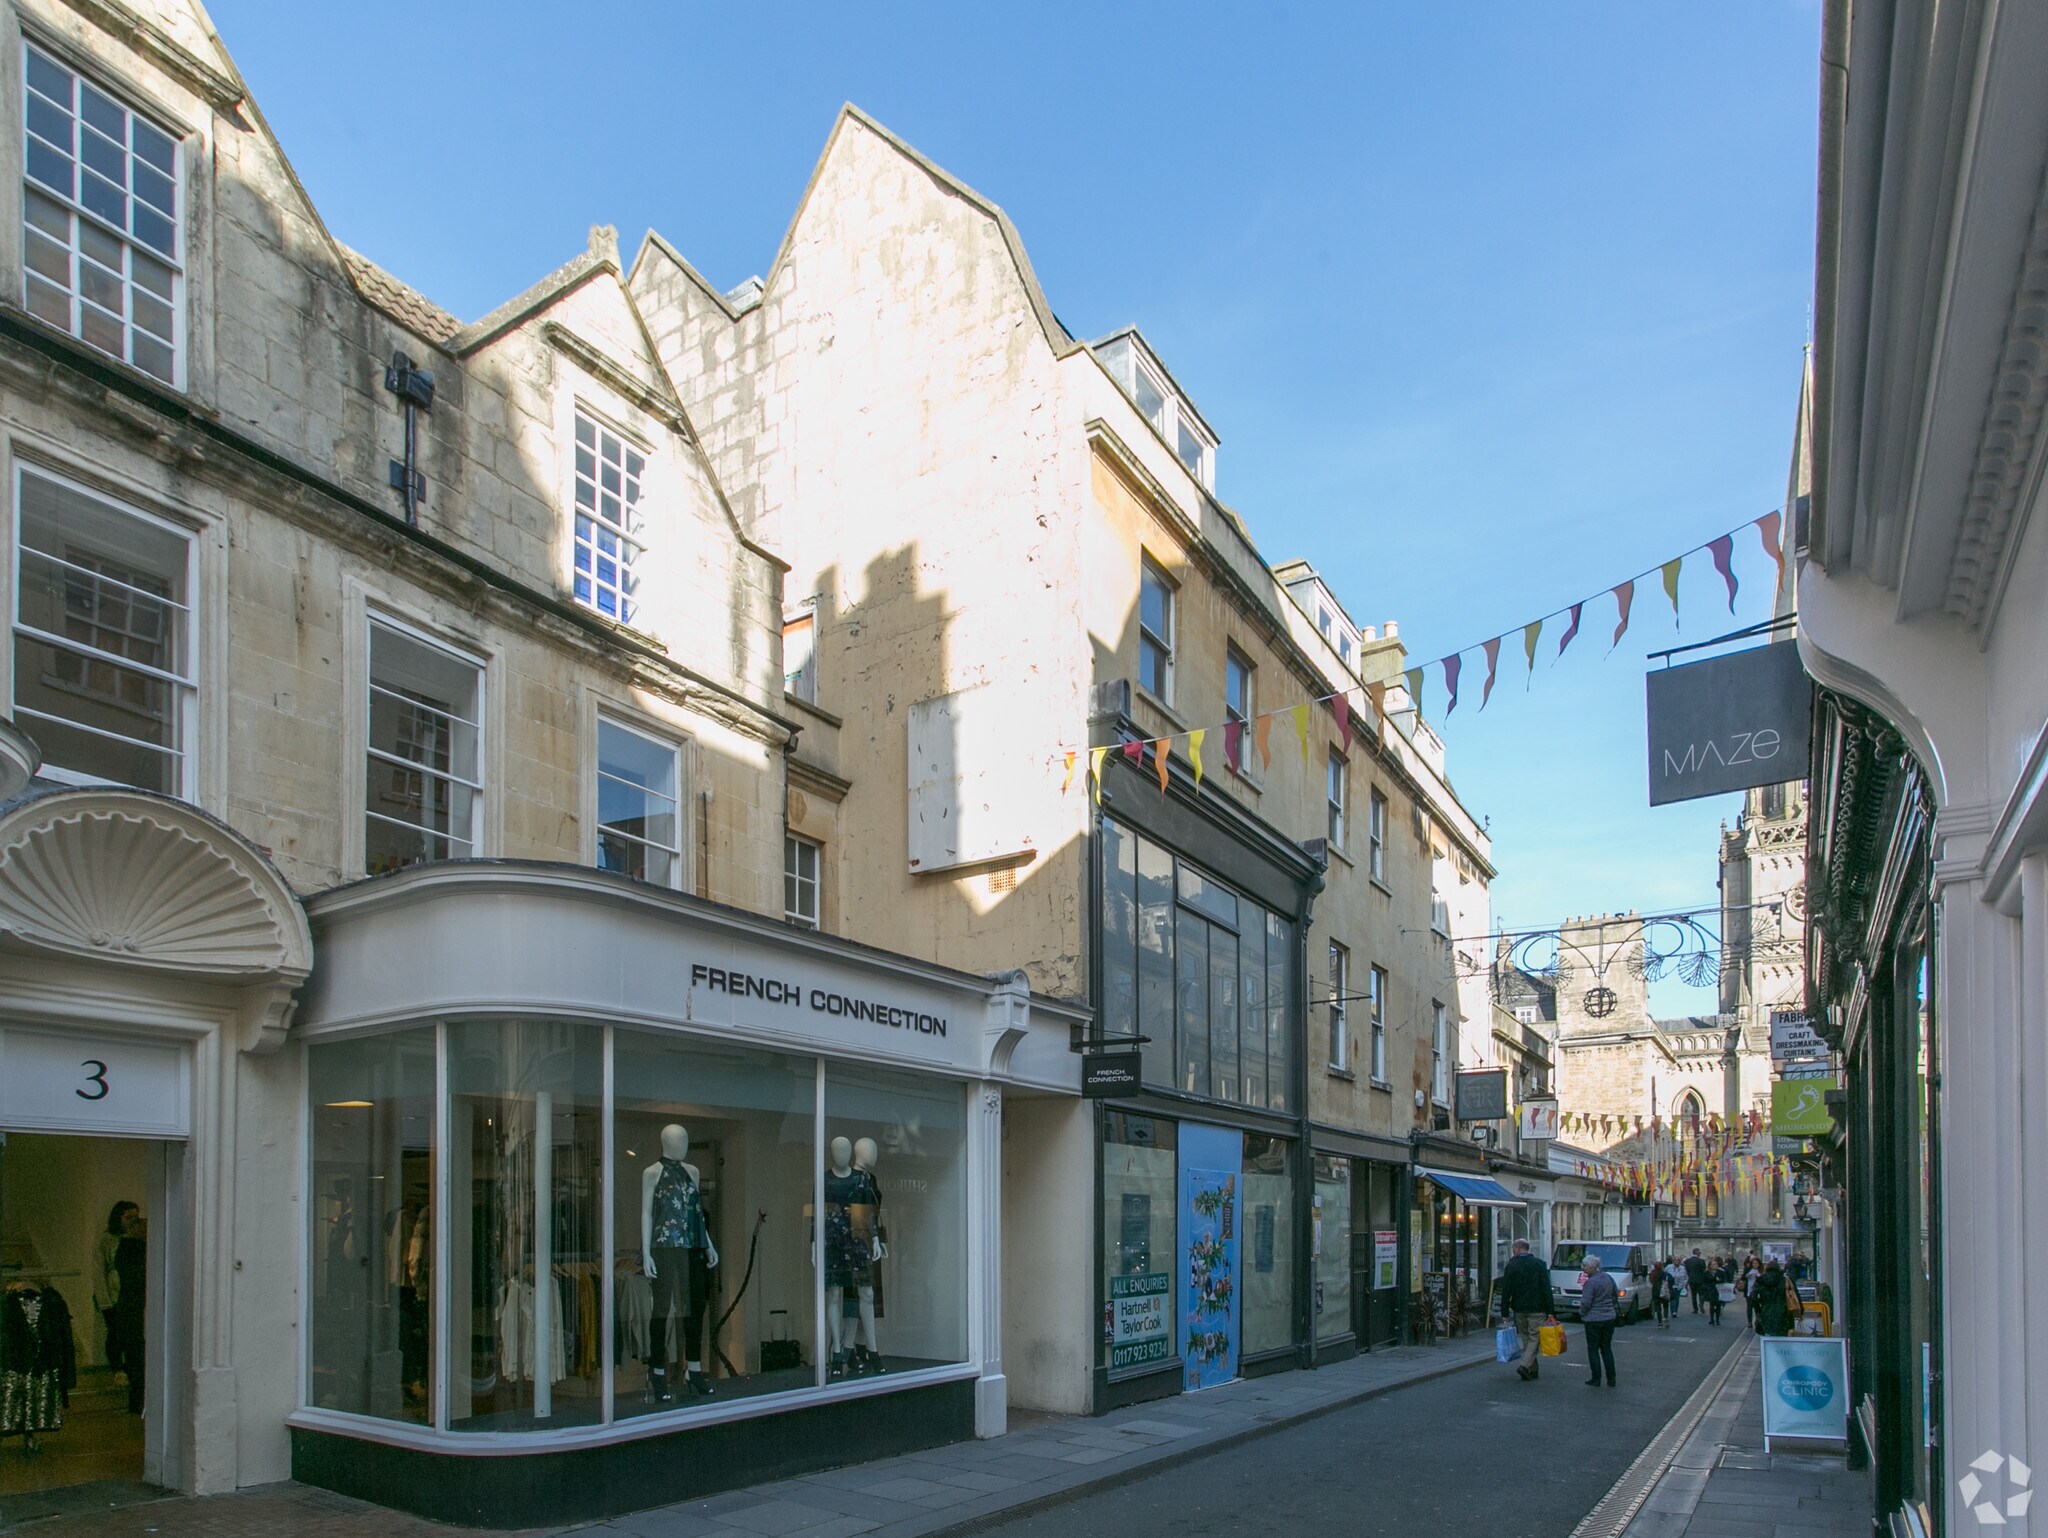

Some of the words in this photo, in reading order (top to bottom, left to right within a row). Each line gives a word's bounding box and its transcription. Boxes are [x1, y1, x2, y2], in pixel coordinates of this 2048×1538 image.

[692, 964, 801, 1007] FRENCH
[810, 990, 947, 1037] CONNECTION
[1788, 1032, 1811, 1040] CRAFT
[1775, 1040, 1824, 1049] DRESSMAKING
[1783, 1049, 1817, 1057] CURTAINS
[76, 1060, 109, 1100] 3
[1088, 1075, 1134, 1083] CONNECTION
[1775, 1122, 1830, 1131] SHUROPODY
[1113, 1280, 1129, 1295] ALL
[1130, 1276, 1167, 1293] ENQUIRIES
[1121, 1298, 1151, 1316] Hartnell
[1121, 1317, 1144, 1337] Taylor
[1144, 1315, 1162, 1331] Cook
[1114, 1346, 1133, 1365] 0117
[1133, 1343, 1148, 1361] 923
[1149, 1340, 1168, 1358] 9234
[1782, 1386, 1829, 1397] CLINIC
